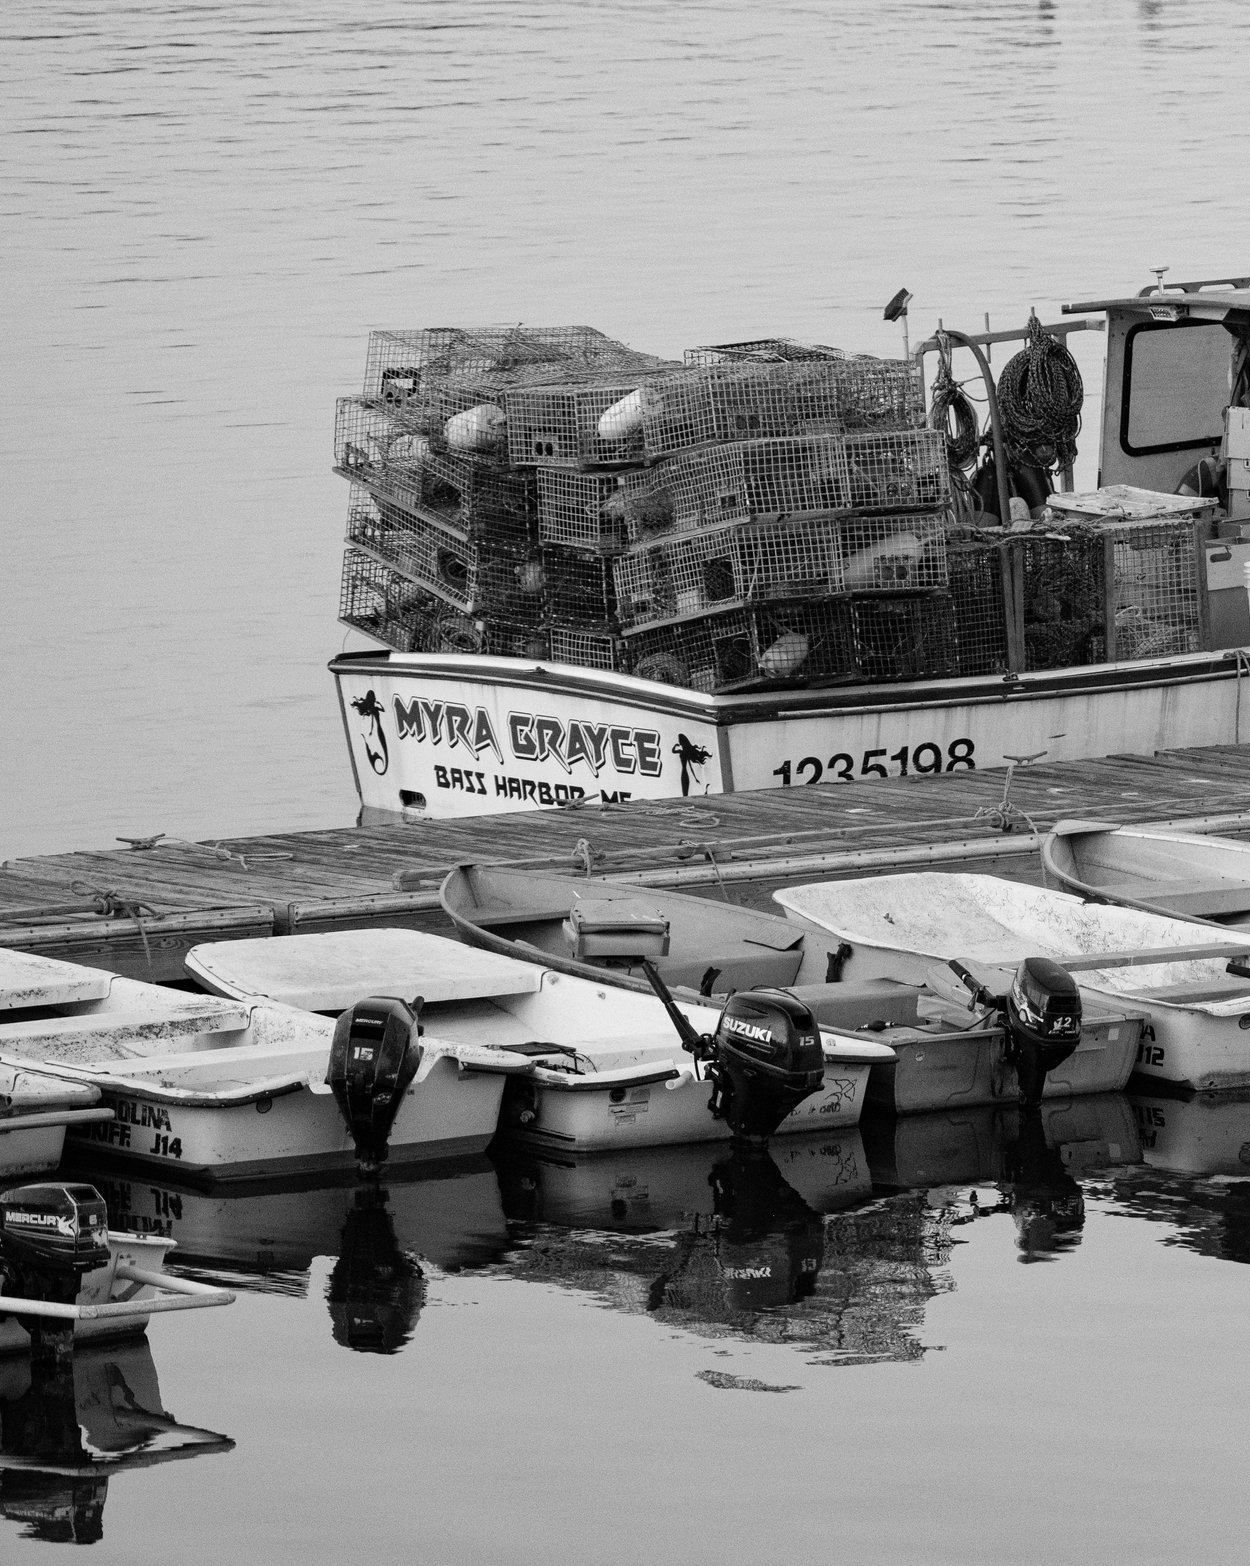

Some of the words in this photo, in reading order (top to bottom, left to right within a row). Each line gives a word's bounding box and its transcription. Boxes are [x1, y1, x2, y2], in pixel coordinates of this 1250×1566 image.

[393, 693, 504, 765] MYRA
[507, 710, 663, 778] GRAYCE
[773, 738, 976, 787] 1235198
[434, 764, 487, 795] BASS
[722, 1016, 773, 1043] SUZUKI
[799, 1035, 815, 1047] 15
[353, 1046, 374, 1061] 15
[1135, 1044, 1165, 1067] J12
[149, 1132, 182, 1159] J14
[5, 1211, 67, 1226] MERCURY
